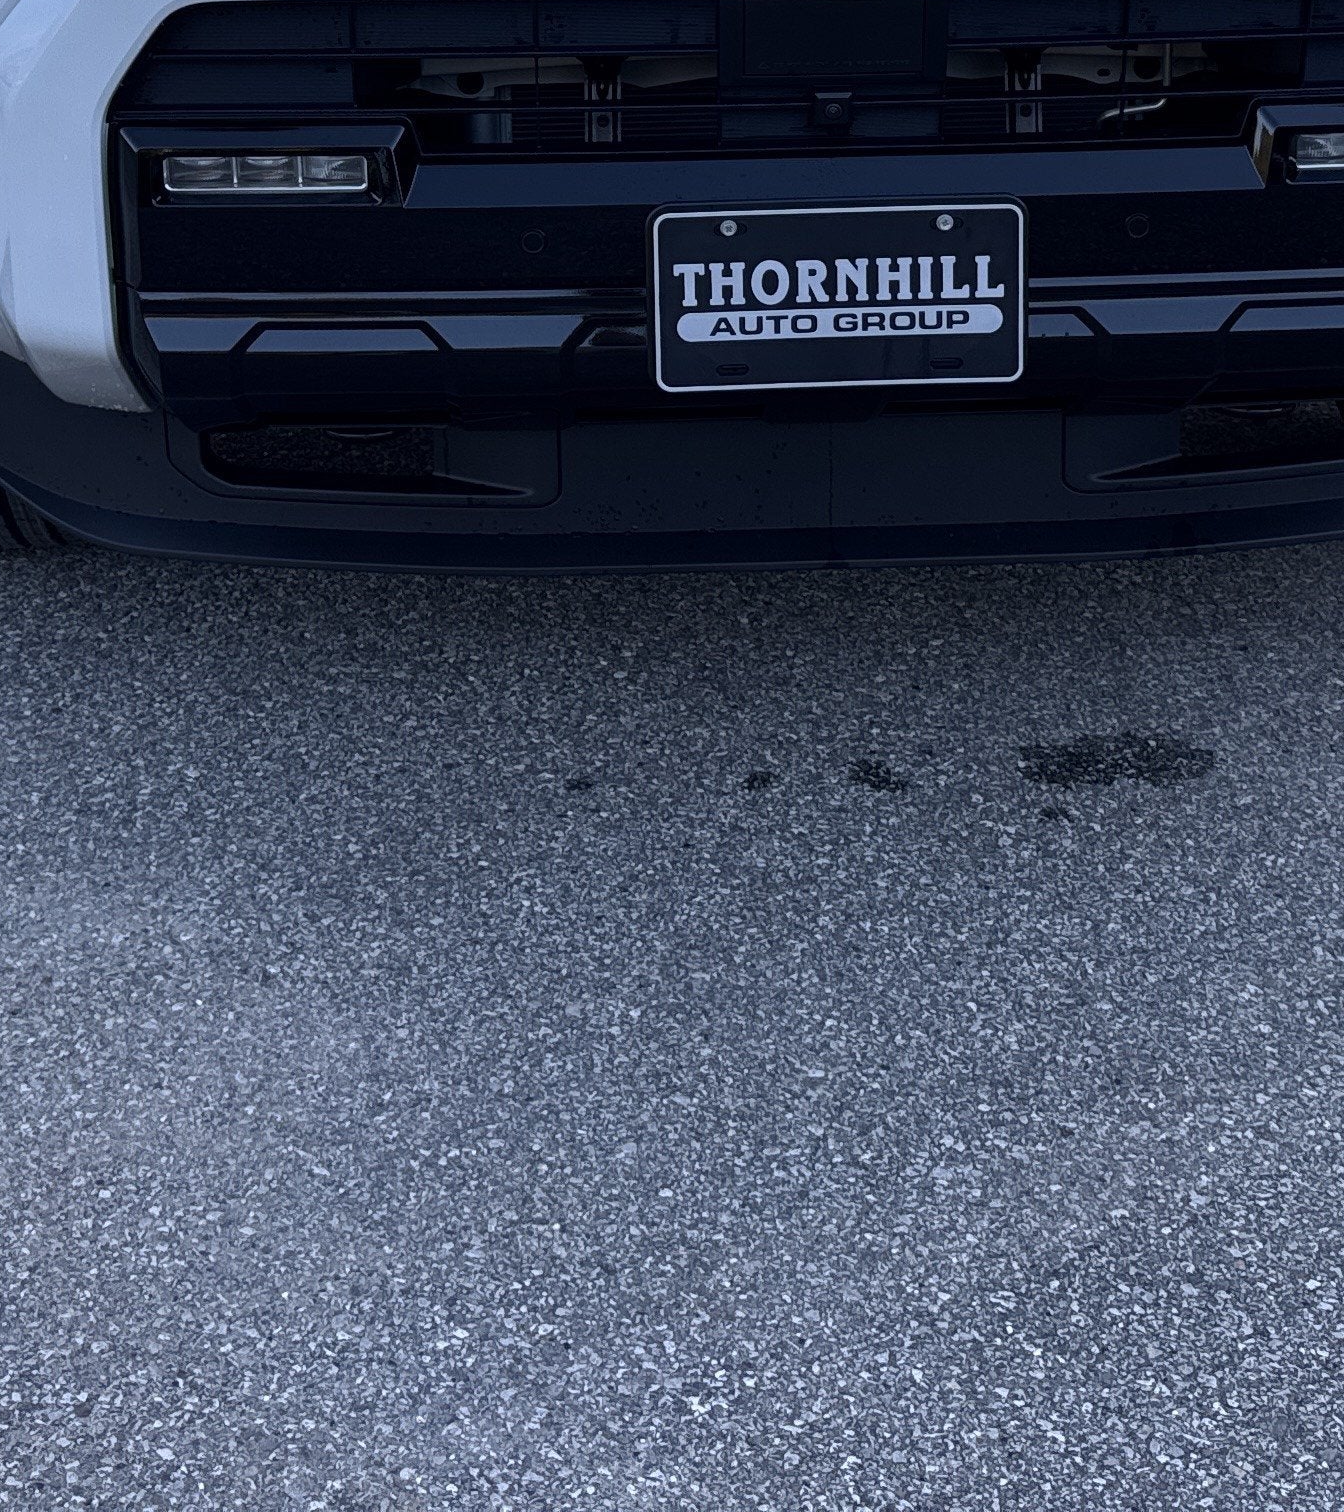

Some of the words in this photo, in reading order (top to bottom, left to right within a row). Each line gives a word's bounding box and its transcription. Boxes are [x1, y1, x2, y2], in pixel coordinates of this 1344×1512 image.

[673, 255, 1005, 307] THORNHILL
[709, 314, 819, 337] AUTO
[833, 309, 970, 333] GROUP
